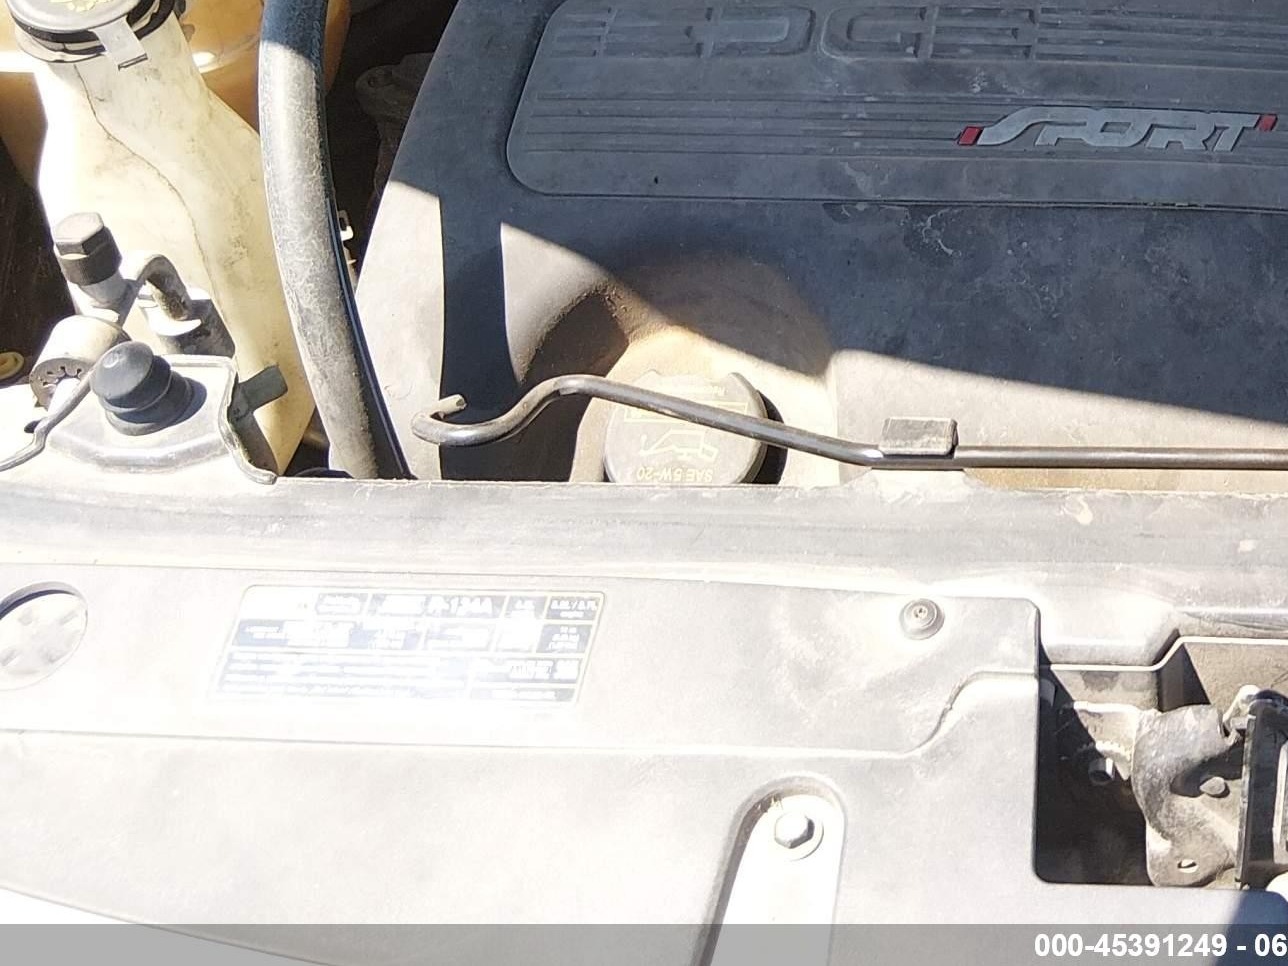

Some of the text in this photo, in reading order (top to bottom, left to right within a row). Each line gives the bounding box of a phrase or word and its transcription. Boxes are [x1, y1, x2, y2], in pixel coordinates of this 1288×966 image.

[597, 4, 1038, 61] EDGE
[977, 106, 1260, 152] SPORT
[686, 467, 714, 484] SAE
